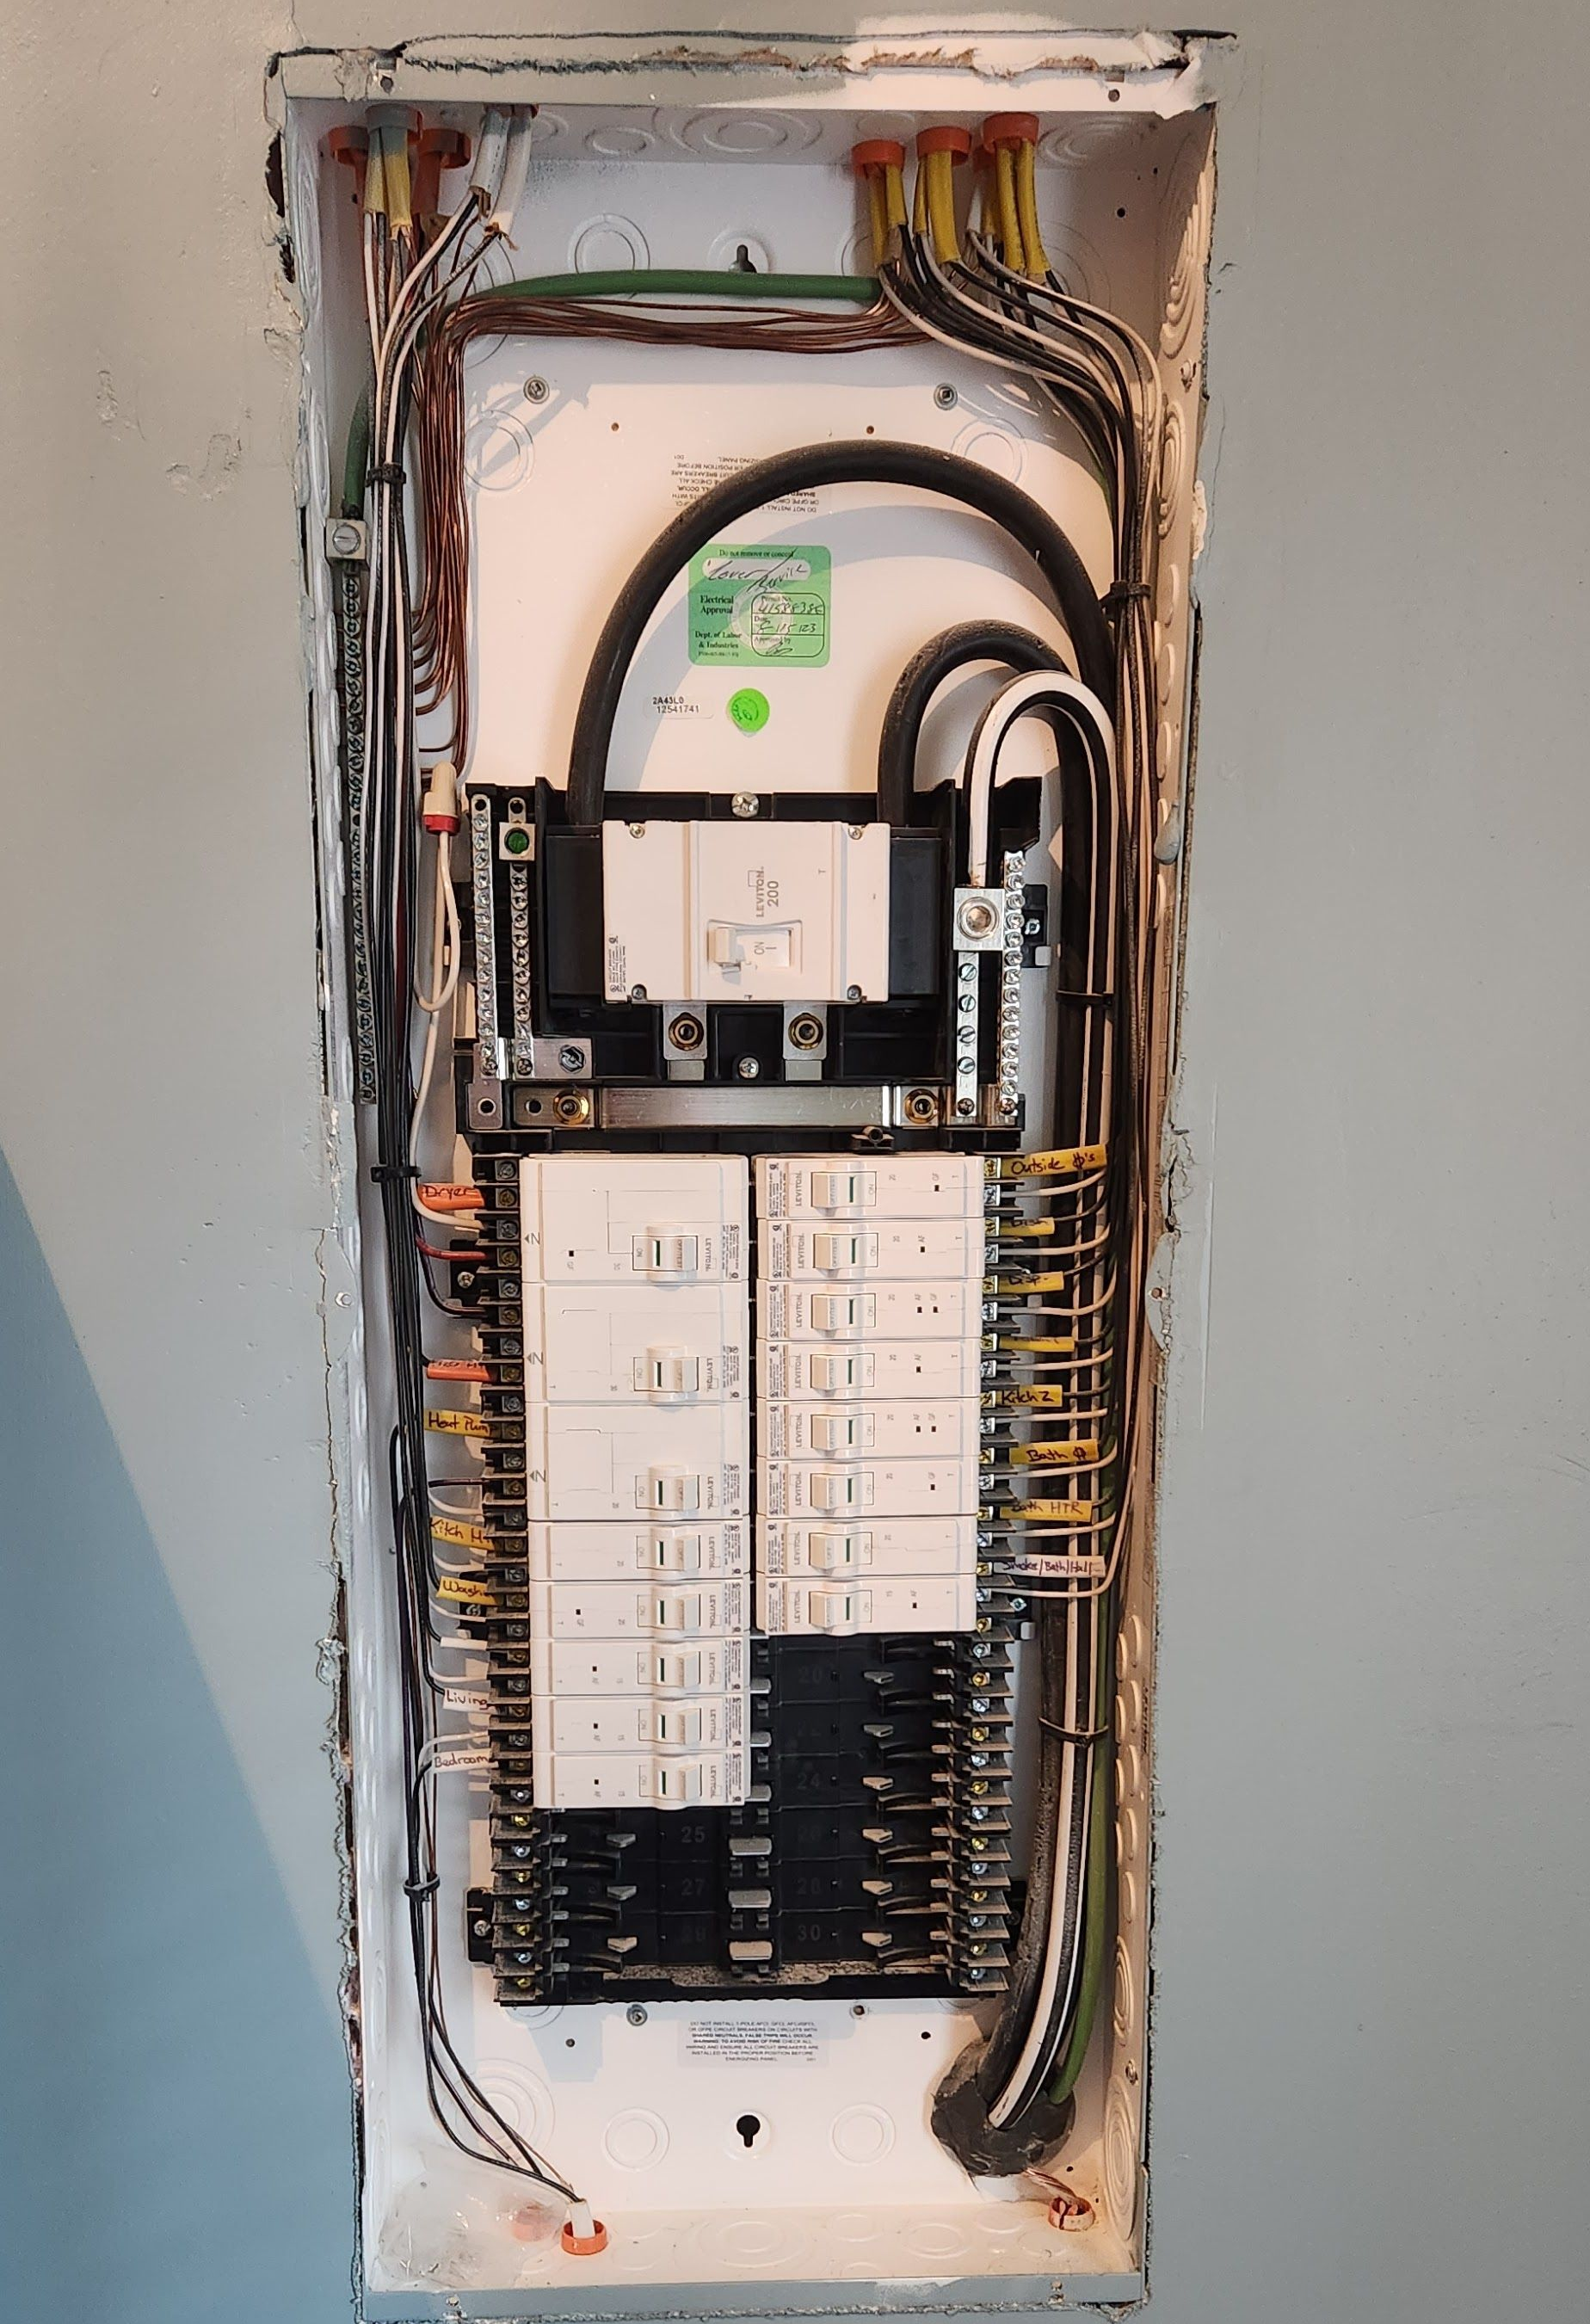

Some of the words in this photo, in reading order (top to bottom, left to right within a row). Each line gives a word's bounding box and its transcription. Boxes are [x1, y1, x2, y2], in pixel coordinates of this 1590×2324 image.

[701, 606, 733, 615] Approval
[767, 879, 780, 907] 200
[754, 941, 764, 955] ON
[1010, 1156, 1065, 1175] Outside
[423, 1185, 474, 1199] Dryer
[1001, 1389, 1037, 1403] Kitch
[428, 1411, 459, 1429] Heat
[1026, 1448, 1069, 1463] Bath
[1050, 1501, 1083, 1515] HTR
[429, 1517, 463, 1538] Kitch
[447, 1689, 489, 1711] Living
[434, 1753, 489, 1767] Bedroom
[680, 1824, 707, 1843] 25
[681, 1877, 707, 1896] 27
[797, 1924, 822, 1943] 30
